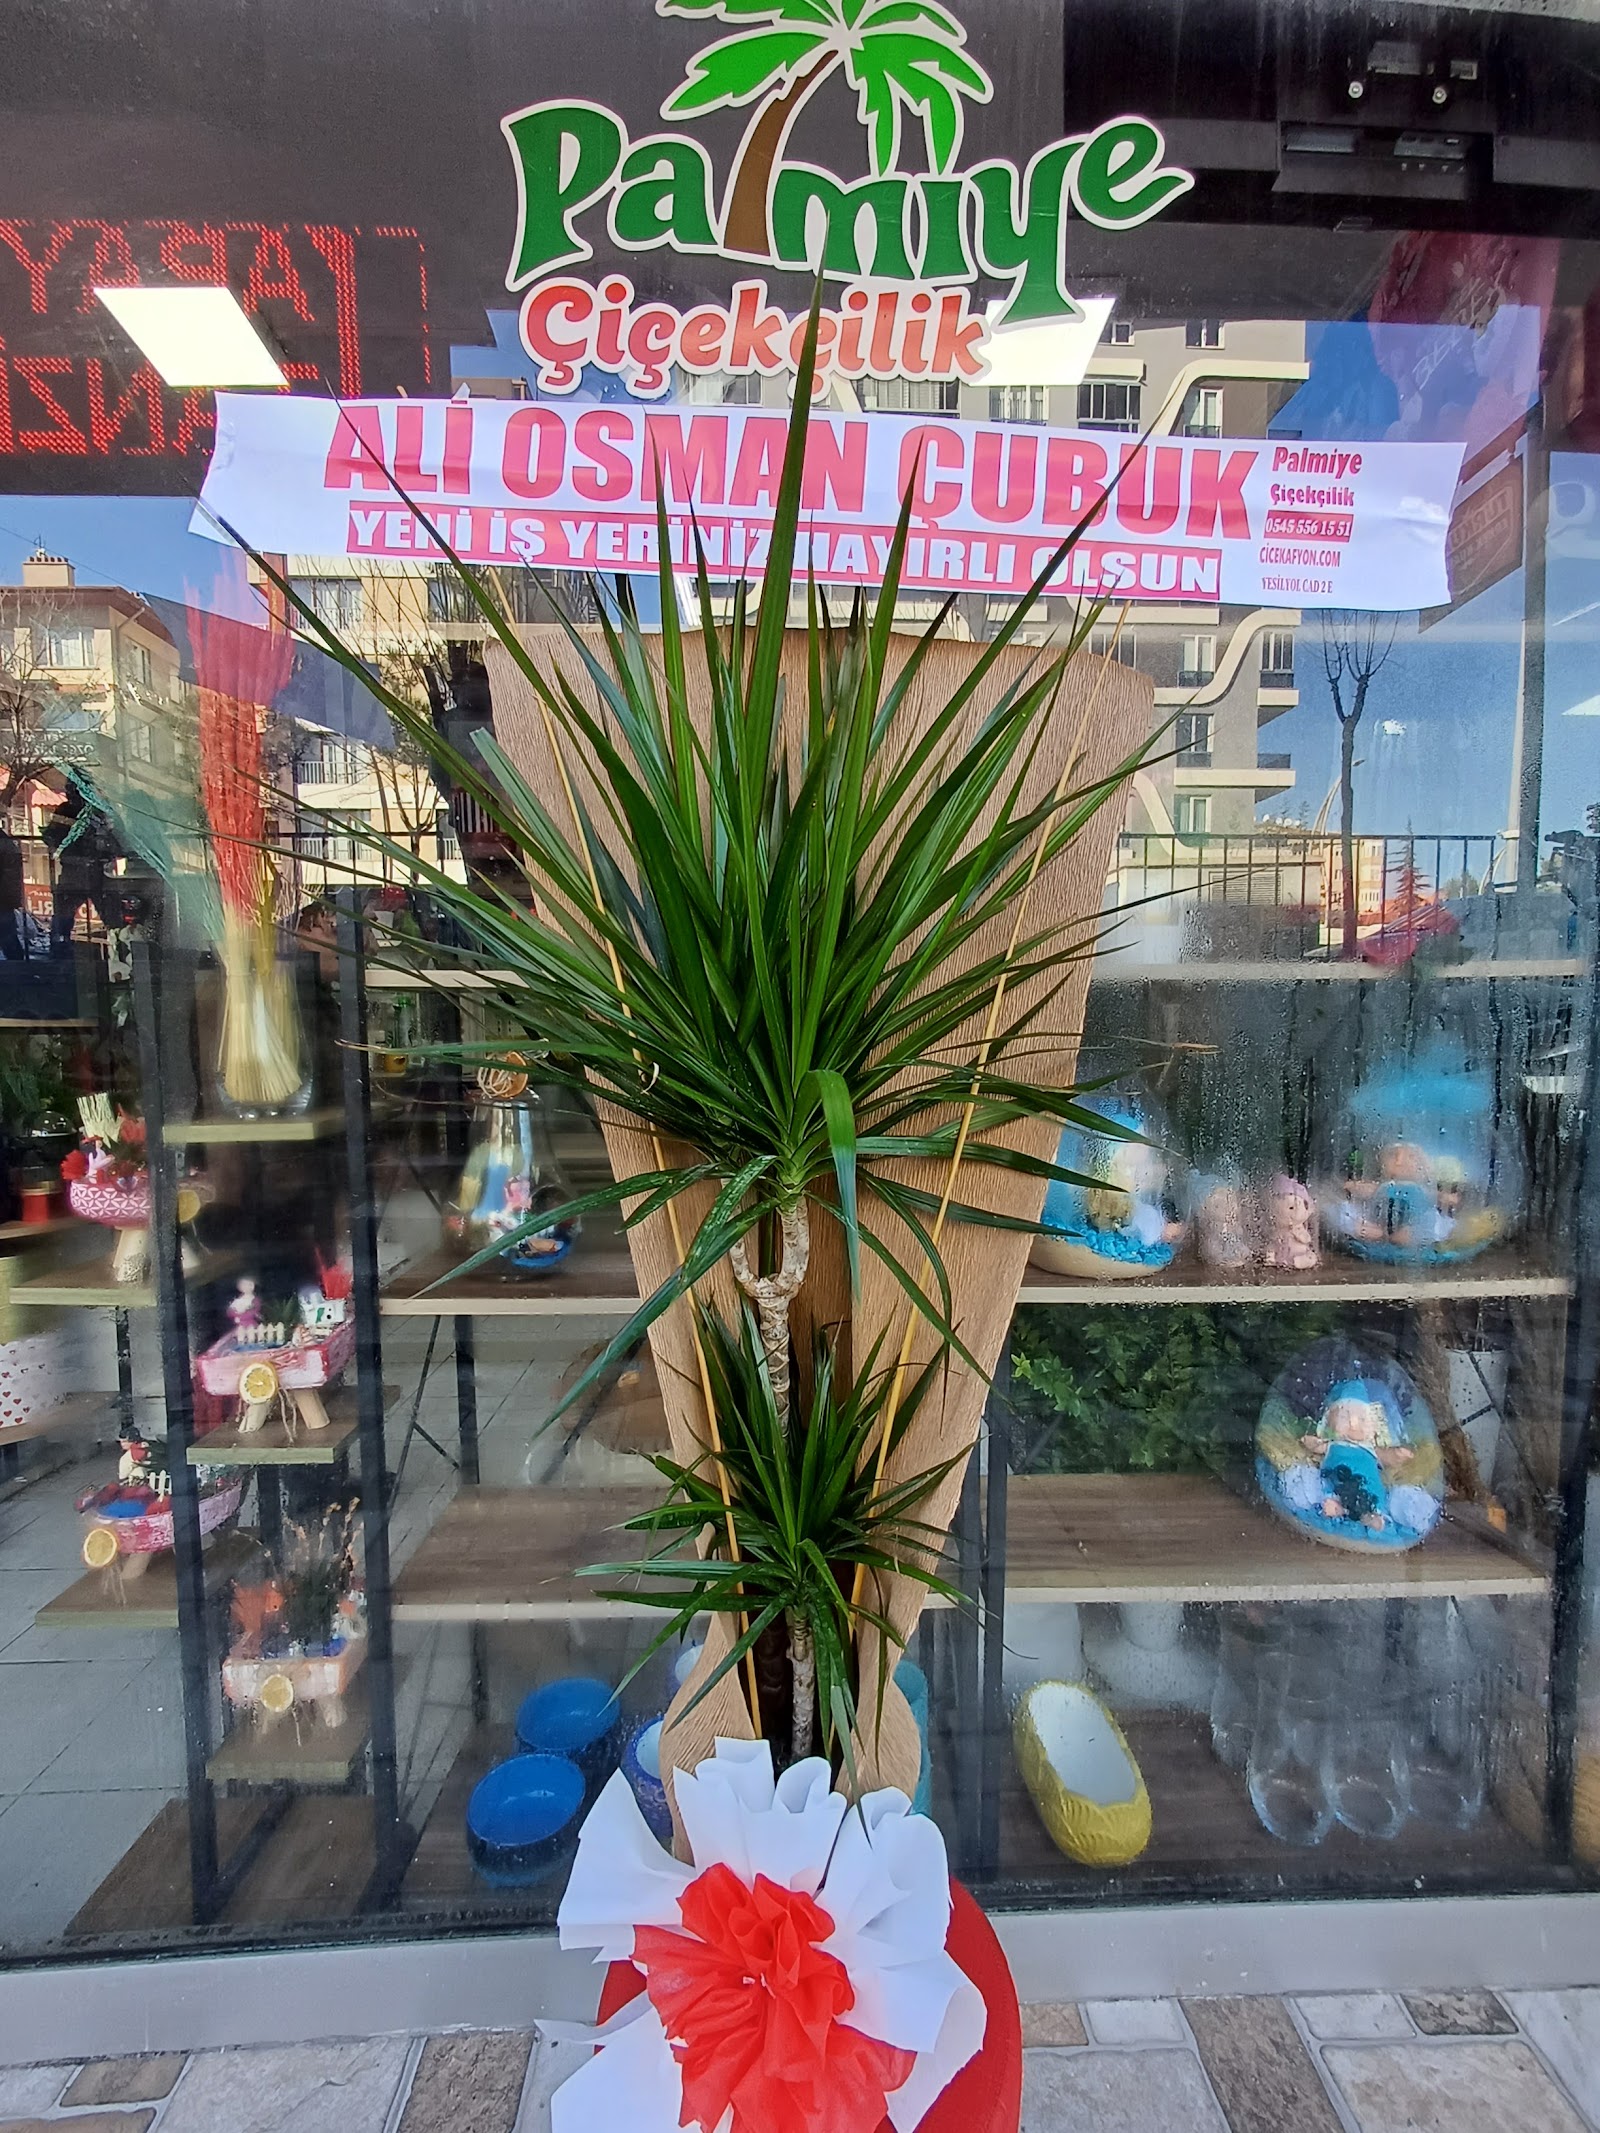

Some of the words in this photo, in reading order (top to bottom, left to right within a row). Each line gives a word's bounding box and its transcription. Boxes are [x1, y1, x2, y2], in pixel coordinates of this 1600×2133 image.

[521, 278, 988, 397] Çiçekçilik
[324, 400, 473, 494] ALİ
[502, 407, 868, 512] OSMAN
[897, 424, 1259, 540] ÇUBUK
[1272, 447, 1362, 479] Palmiye
[1270, 484, 1354, 507] Çiçekçilik
[1265, 518, 1295, 534] 0545
[1296, 519, 1318, 535] 556
[1320, 520, 1335, 536] 15
[1337, 521, 1351, 537] 51
[350, 507, 473, 551] YENİ
[489, 510, 546, 562] İŞ
[560, 516, 772, 568] YERİNİZ
[791, 531, 1016, 584] HAYIRLI
[1030, 546, 1218, 594] OLSUN
[1302, 579, 1320, 593] CAD
